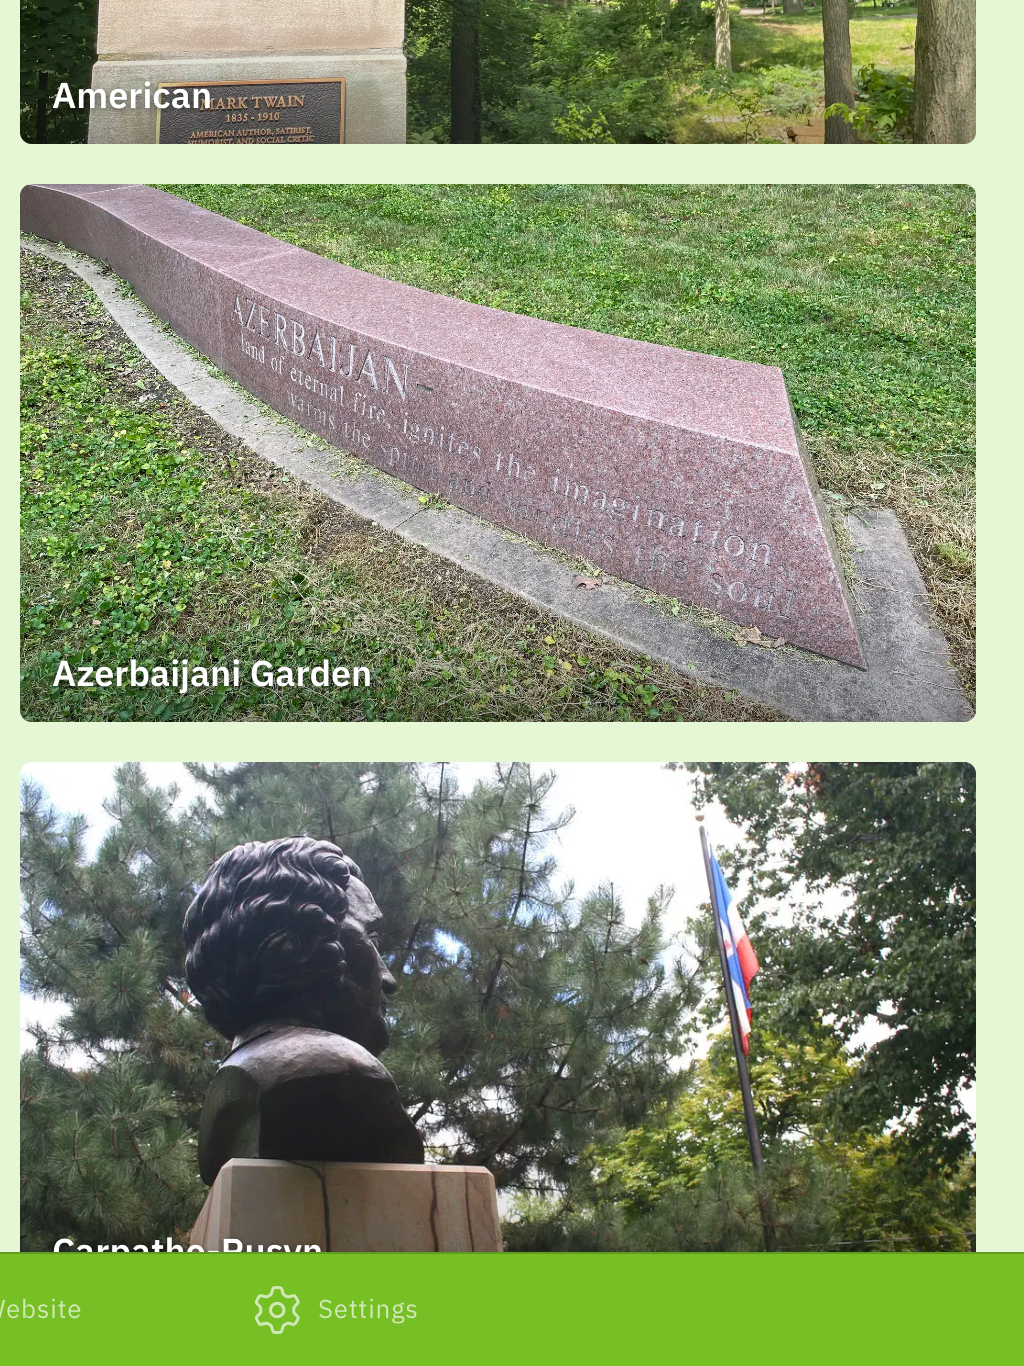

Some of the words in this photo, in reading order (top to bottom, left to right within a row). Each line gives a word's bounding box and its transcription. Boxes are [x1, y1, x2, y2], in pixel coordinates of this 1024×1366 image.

[200, 96, 247, 111] MARK
[250, 94, 305, 110] TWAIN
[225, 113, 248, 123] 1835
[257, 112, 280, 122] 1910
[190, 130, 235, 139] AMERICAN
[237, 128, 274, 138] AUTHOR,
[256, 136, 284, 144] SOCIAL
[287, 134, 314, 143] CRITIC
[231, 295, 411, 401] AZERBAIJAN
[240, 333, 265, 364] land
[270, 355, 284, 375] of
[290, 366, 344, 406] eternal
[403, 412, 482, 463] ignites
[496, 452, 536, 482] the
[286, 389, 336, 432] warms
[343, 420, 372, 449] the
[707, 571, 798, 619] soul
[318, 1298, 418, 1325] Settings
